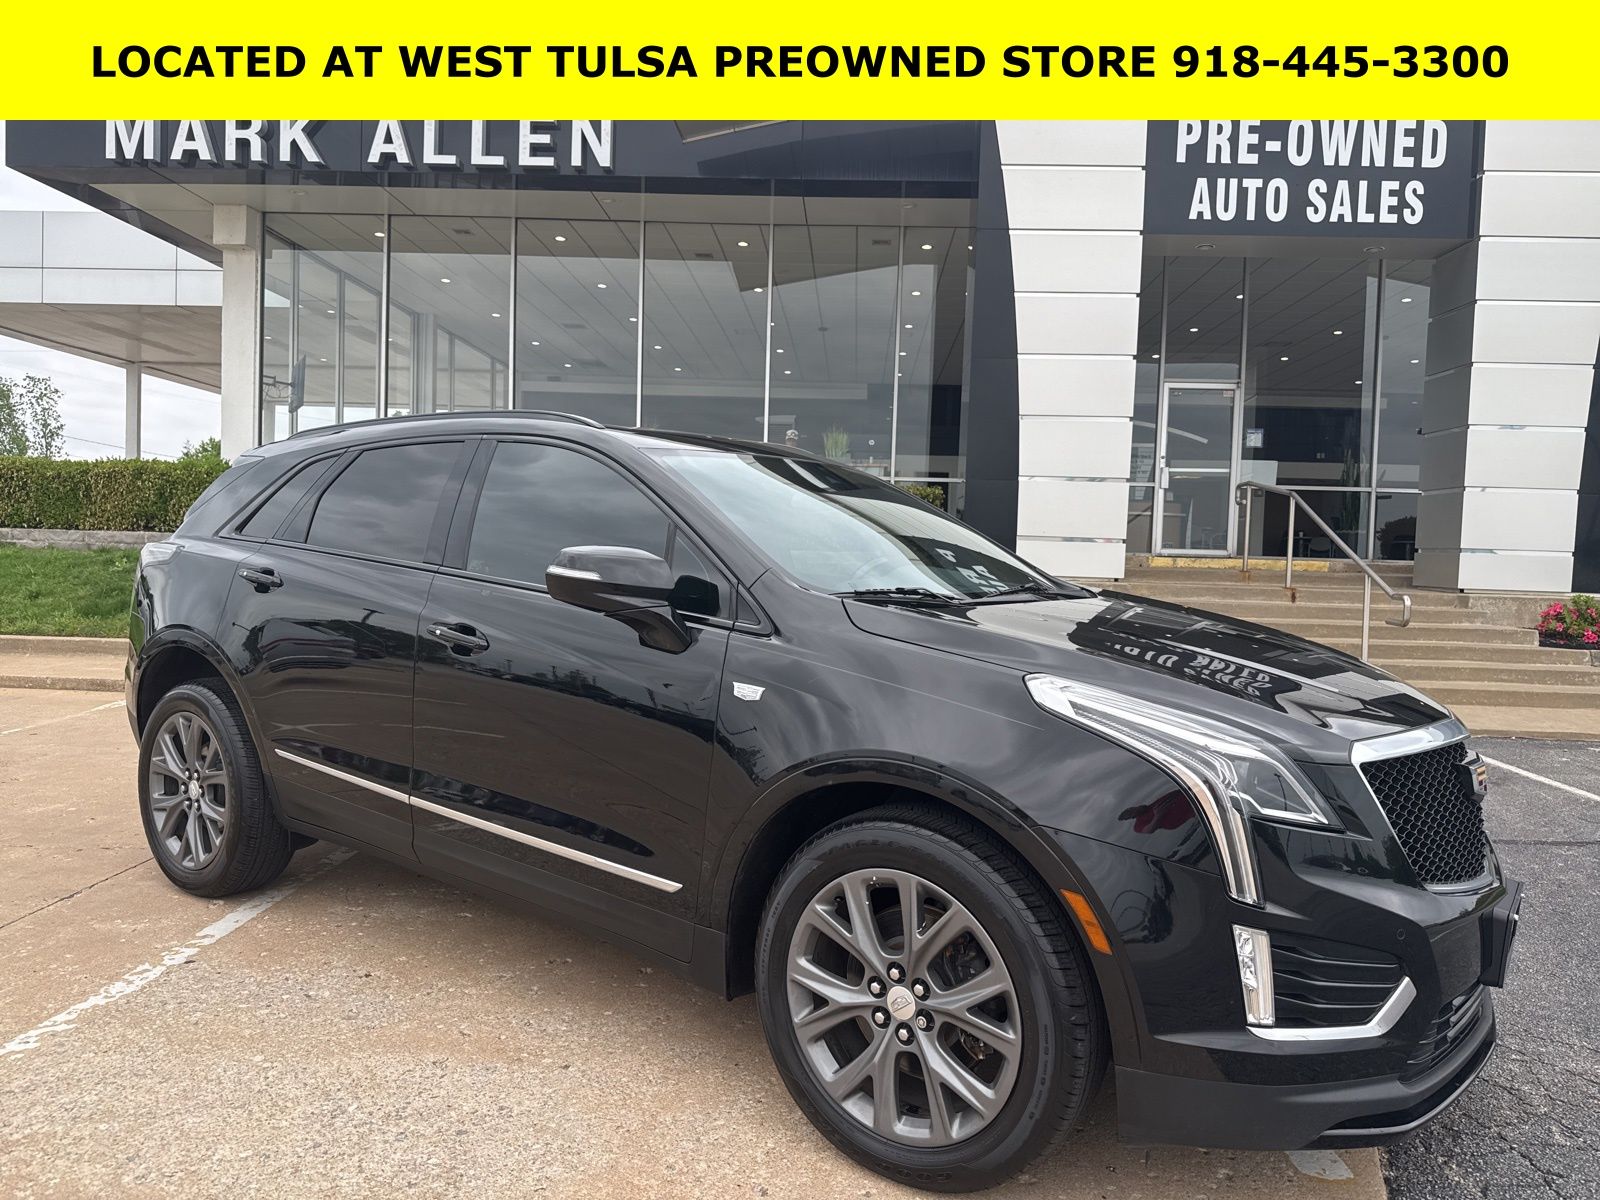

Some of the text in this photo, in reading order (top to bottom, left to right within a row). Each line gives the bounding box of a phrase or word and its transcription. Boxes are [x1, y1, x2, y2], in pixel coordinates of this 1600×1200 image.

[105, 119, 614, 168] MARK ALLEN
[1176, 119, 1448, 168] PRE-OWNED
[1188, 177, 1425, 225] AUTO SALES
